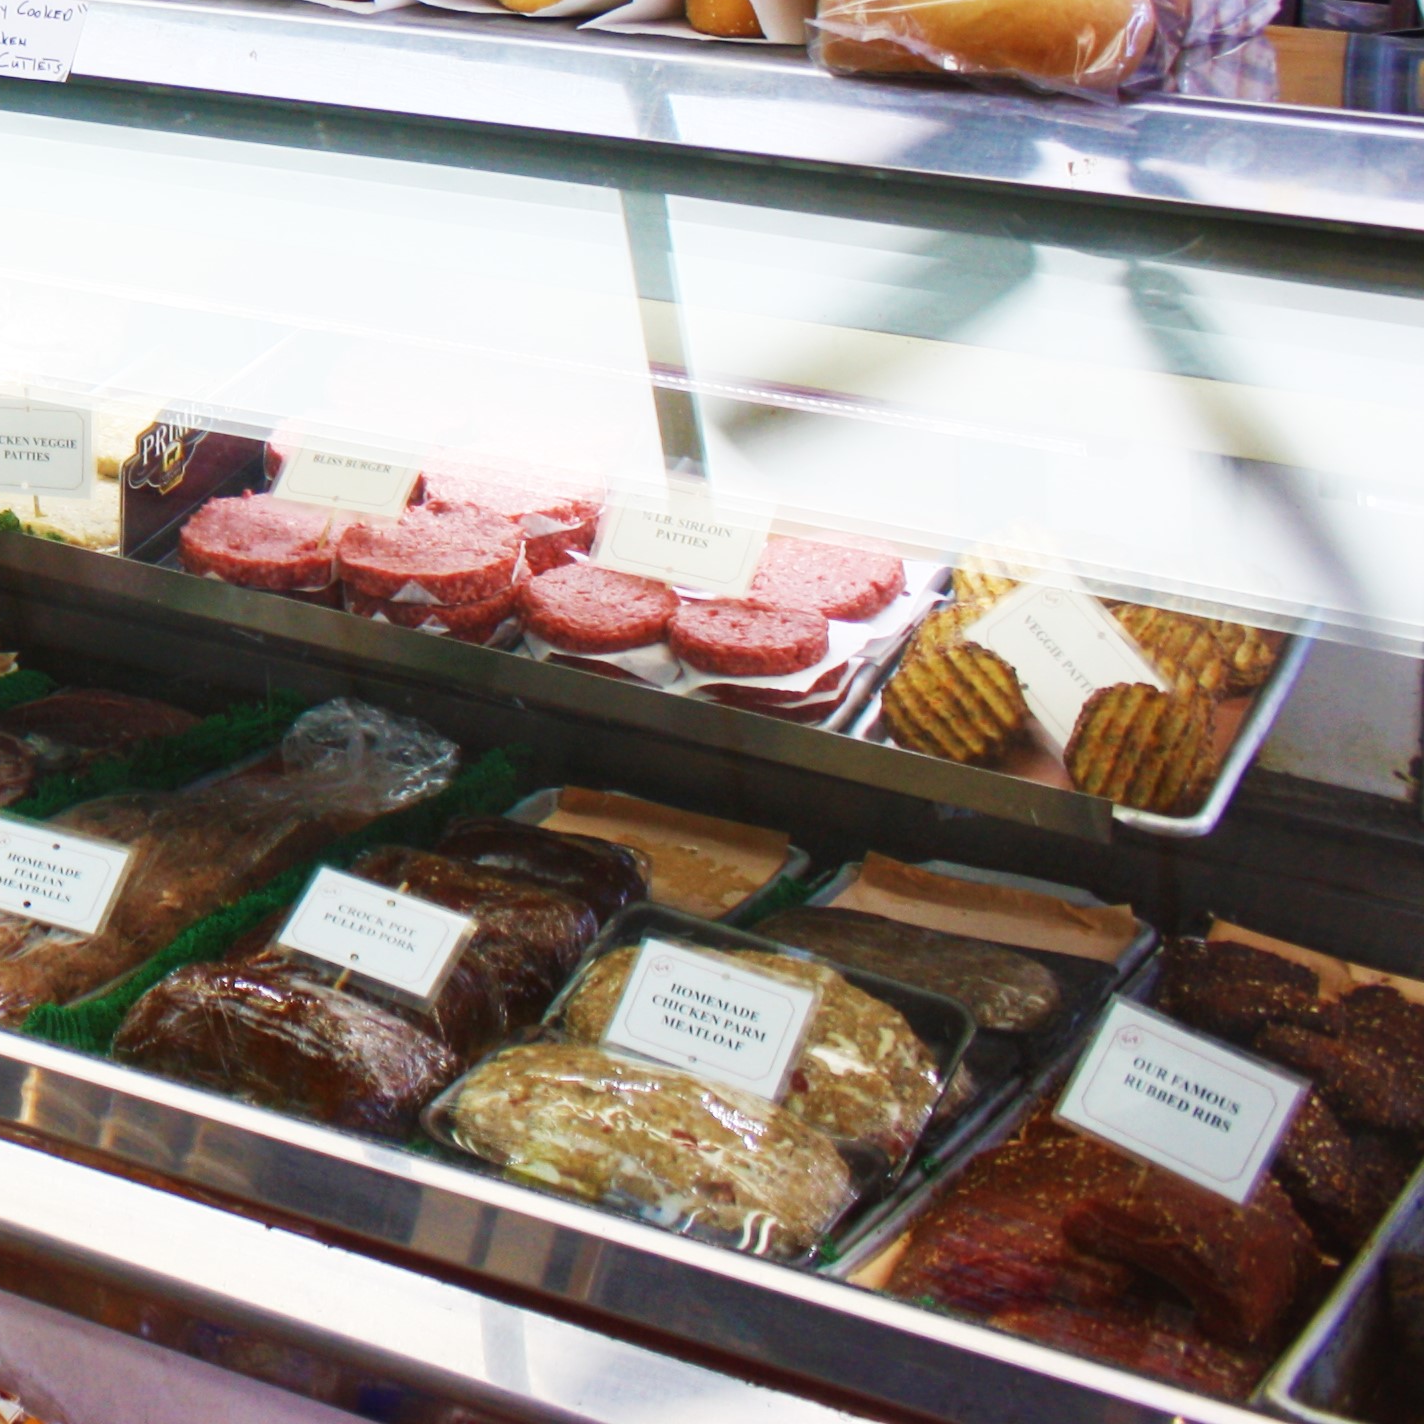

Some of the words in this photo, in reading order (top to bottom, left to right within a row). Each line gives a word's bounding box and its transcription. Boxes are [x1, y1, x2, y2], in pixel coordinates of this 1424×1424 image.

[33, 436, 78, 449] VEGGIE
[142, 403, 202, 466] PRIME
[3, 448, 51, 463] PATTIES
[313, 453, 343, 466] BLISS
[346, 457, 392, 474] BURGER
[655, 528, 710, 550] PATTIES
[678, 518, 732, 538] SIRLOIN
[1022, 612, 1062, 663] VEGGIE
[1059, 656, 1096, 696] PATTI
[6, 852, 83, 880] HOMEMADE
[13, 866, 66, 888] ITALIAN
[323, 911, 379, 936] PULLED
[379, 932, 417, 953] PORK
[337, 902, 385, 926] CROCK
[387, 919, 418, 937] POT
[652, 993, 721, 1027] CHICKEN
[723, 1018, 767, 1043] PARM
[670, 982, 761, 1023] HOMEMADE
[661, 1014, 746, 1052] MEATLOAF
[1123, 1072, 1190, 1114] RUBBED
[1191, 1106, 1233, 1135] RIBS
[1132, 1055, 1168, 1081] OUR
[1170, 1072, 1242, 1117] FAMOUS
